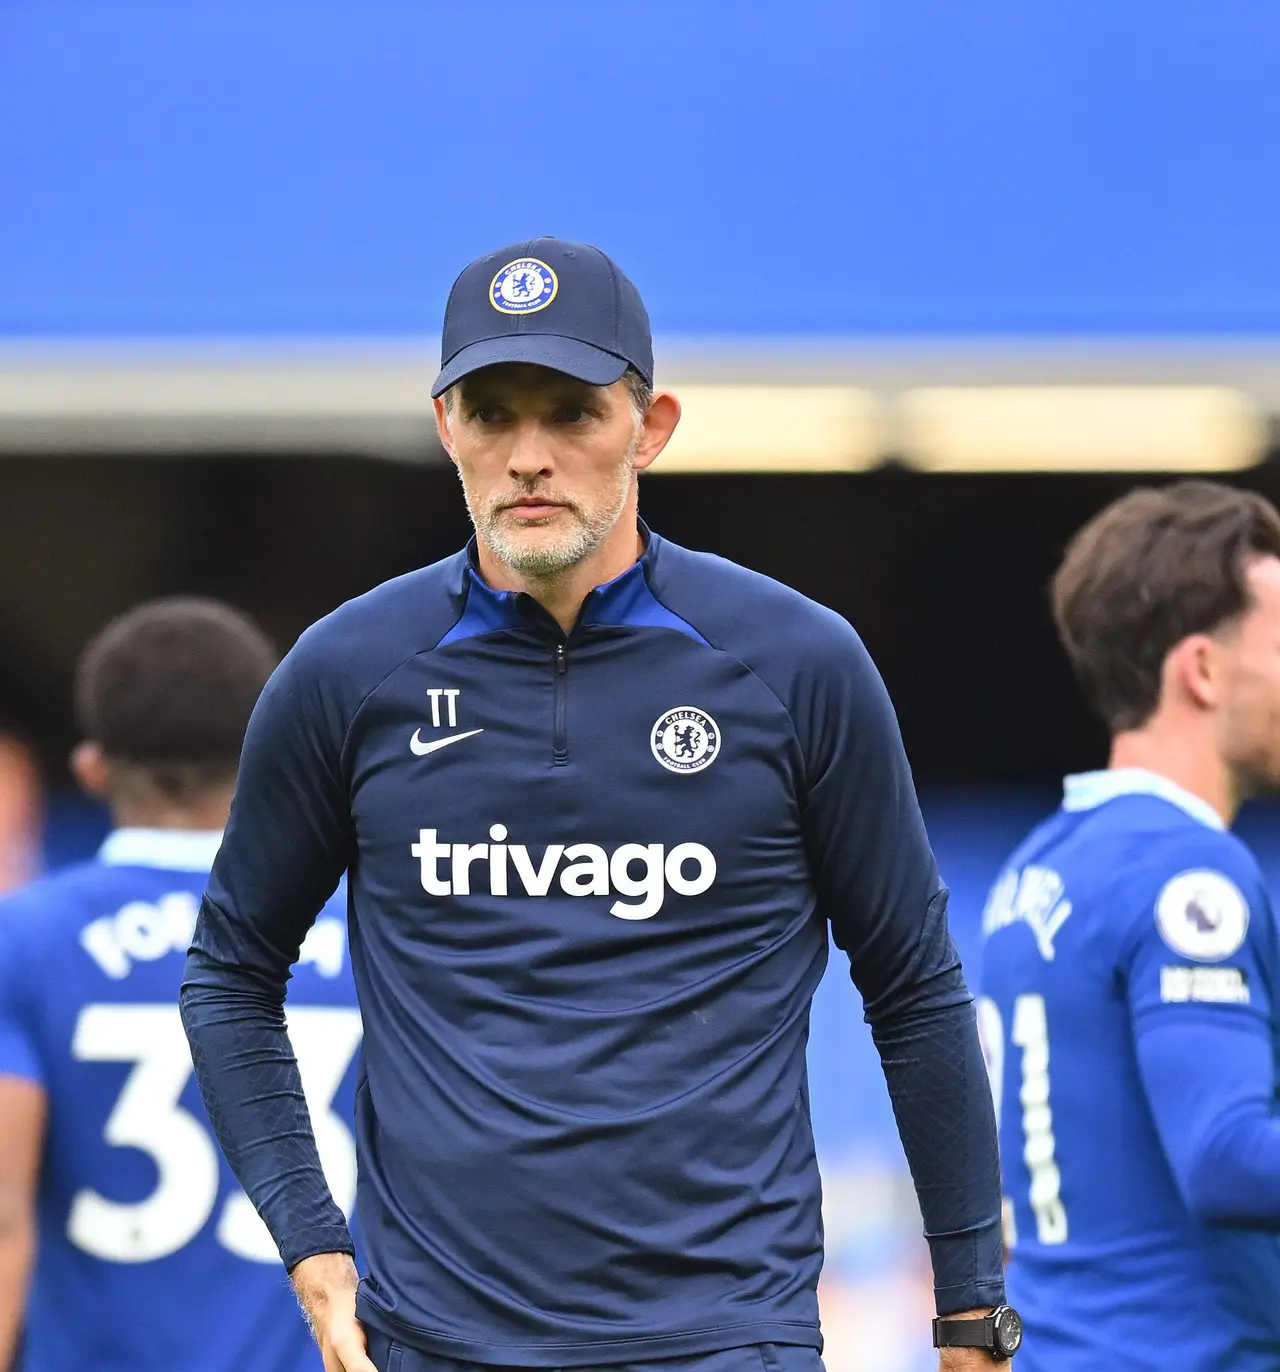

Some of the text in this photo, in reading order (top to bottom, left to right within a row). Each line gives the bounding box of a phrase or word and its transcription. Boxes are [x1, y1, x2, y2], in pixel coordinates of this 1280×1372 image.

[504, 262, 542, 276] CHELSEA
[426, 688, 461, 728] TT
[664, 711, 707, 727] CHELSEA
[411, 823, 717, 921] trivago
